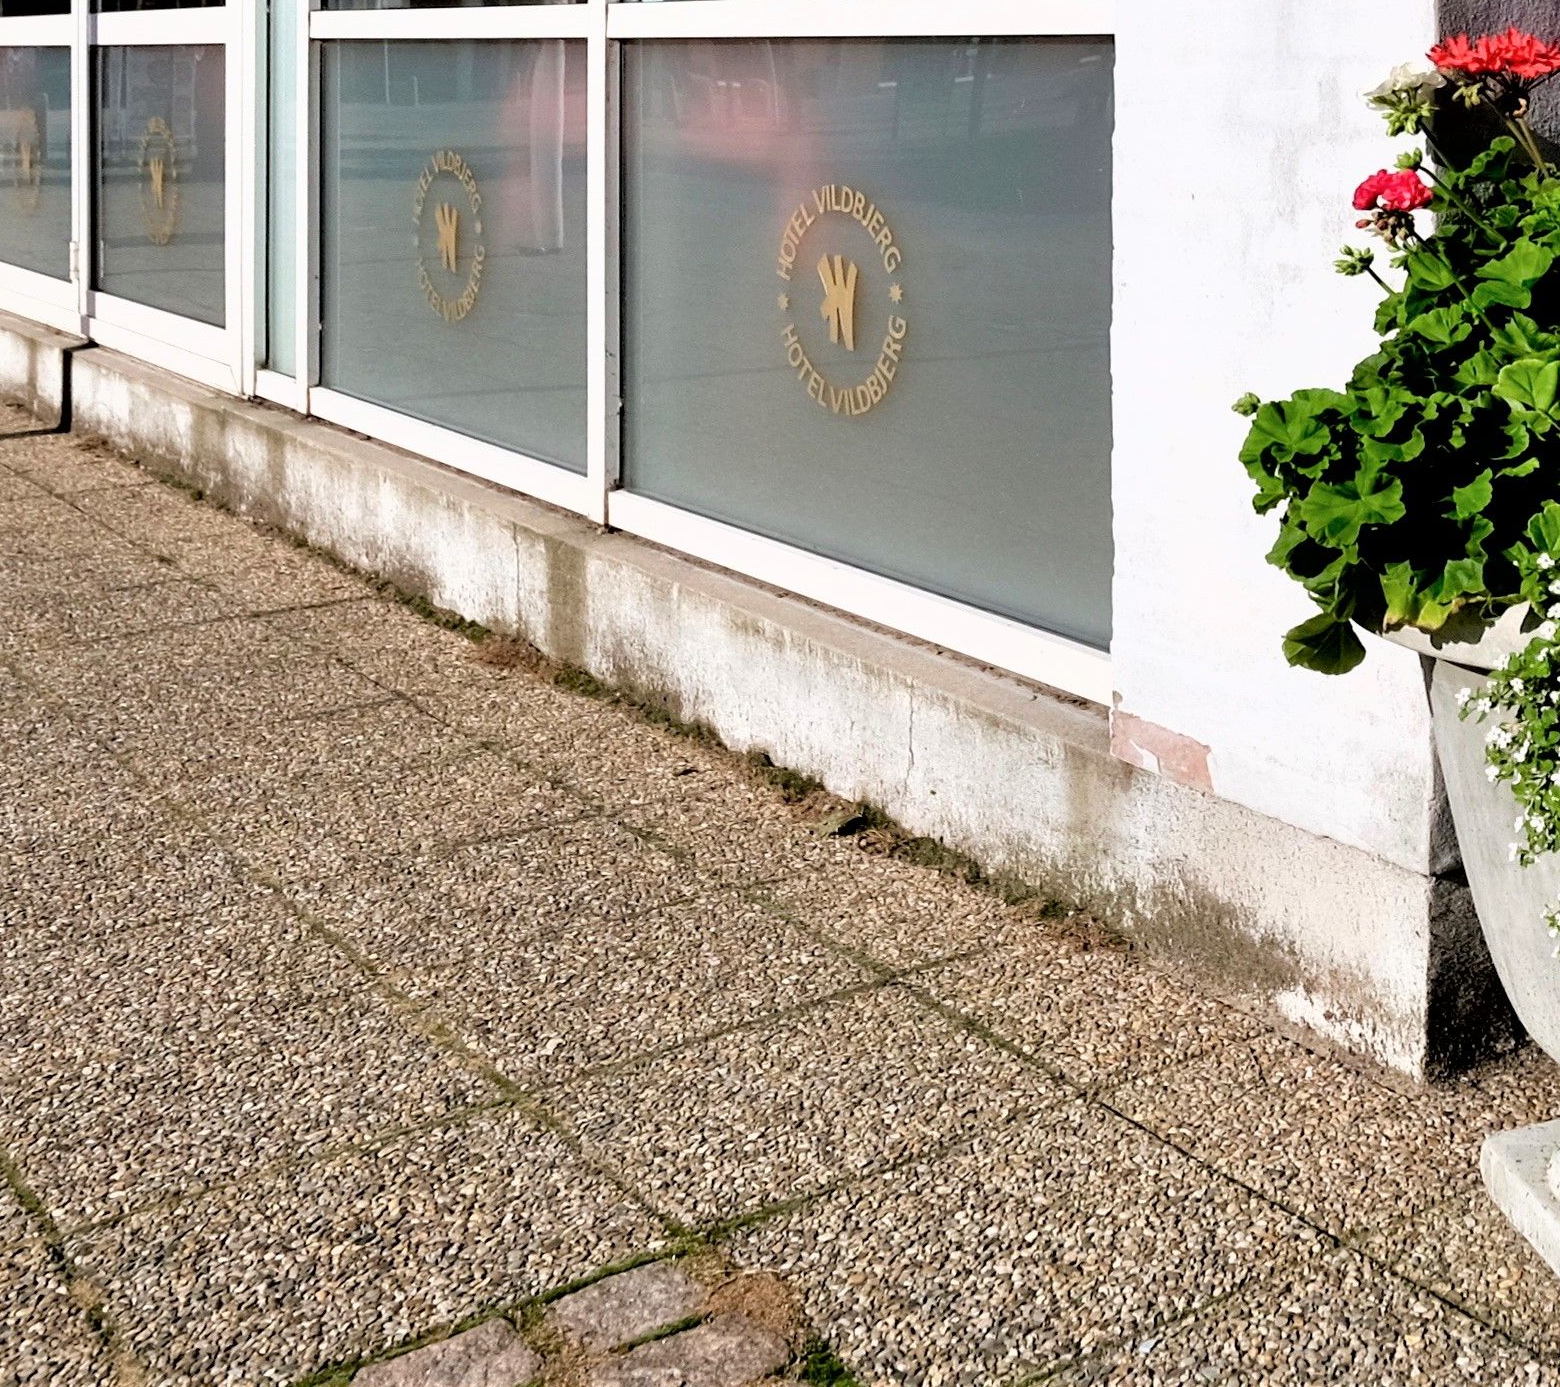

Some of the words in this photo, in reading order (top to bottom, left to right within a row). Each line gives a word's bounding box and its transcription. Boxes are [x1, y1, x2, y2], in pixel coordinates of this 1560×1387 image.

[776, 203, 815, 281] HOTEL
[811, 183, 902, 275] VILDBJERG
[780, 322, 828, 408] HOTEL
[829, 314, 907, 417] VILDBJERG
